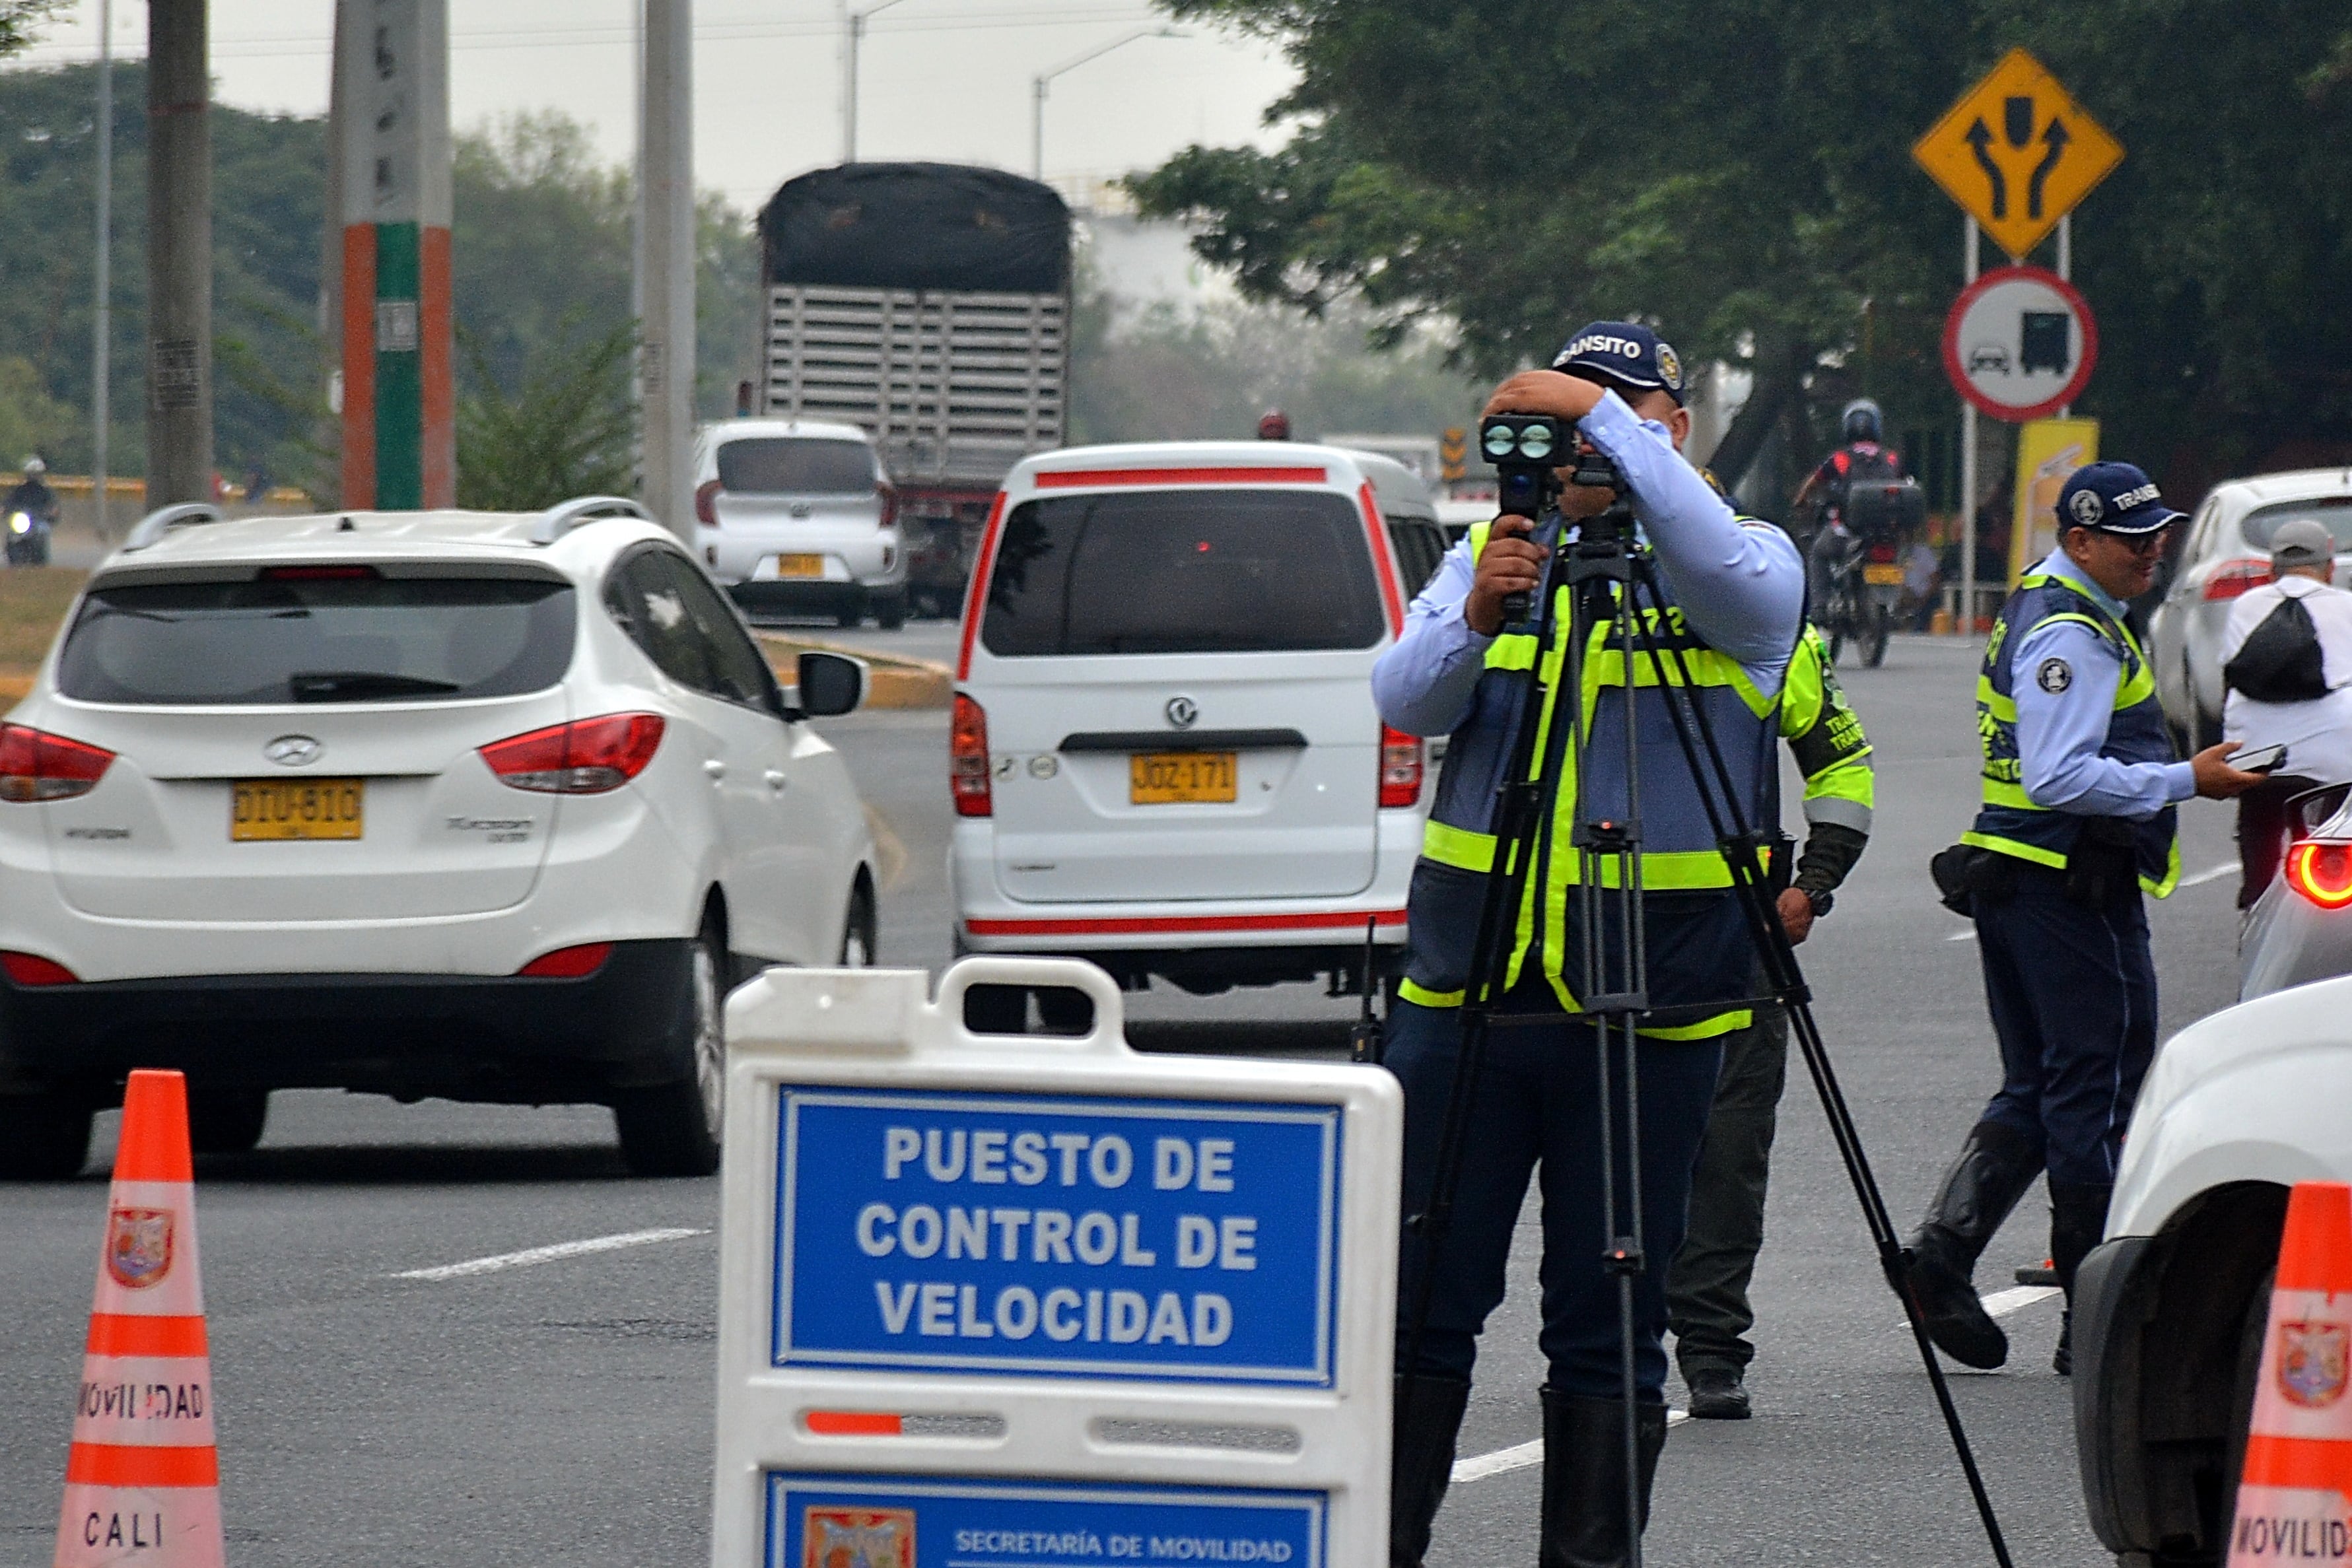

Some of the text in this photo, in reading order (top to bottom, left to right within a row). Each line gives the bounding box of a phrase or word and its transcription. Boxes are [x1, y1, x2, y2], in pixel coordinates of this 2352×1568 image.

[884, 1127, 1235, 1192] PUESTO DE
[856, 1203, 1257, 1271] CONTROL DE
[874, 1281, 1233, 1347] VELOCIDAD
[85, 1511, 162, 1548] CALI
[955, 1529, 1293, 1563] SECRETARÍA DE MOVILIDAD
